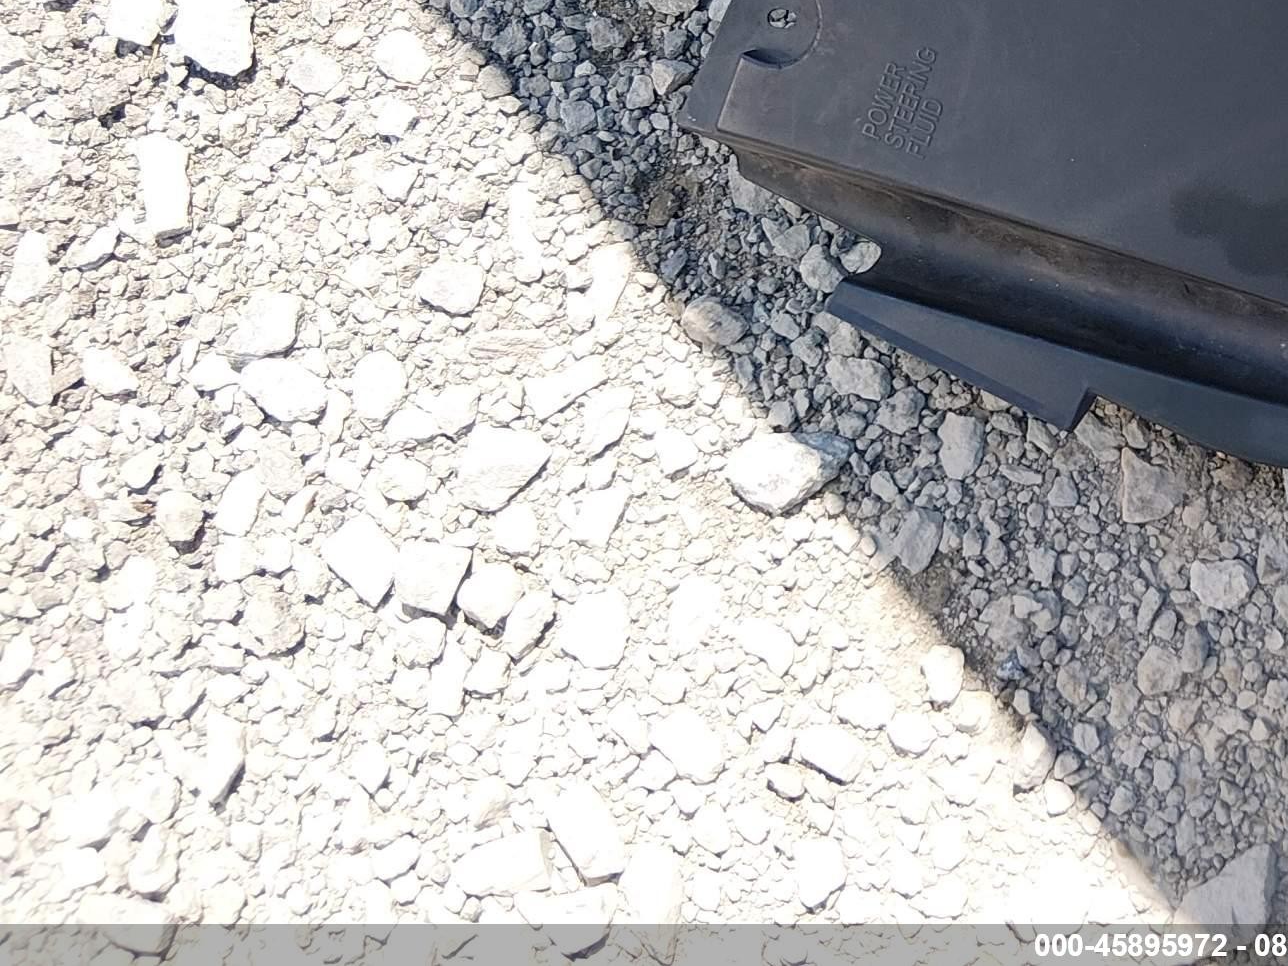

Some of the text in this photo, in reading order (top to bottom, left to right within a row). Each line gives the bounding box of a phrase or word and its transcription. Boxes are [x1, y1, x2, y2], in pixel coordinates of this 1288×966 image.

[862, 62, 906, 140] POWER
[885, 47, 937, 149] STEERING
[906, 99, 943, 160] FLUID
